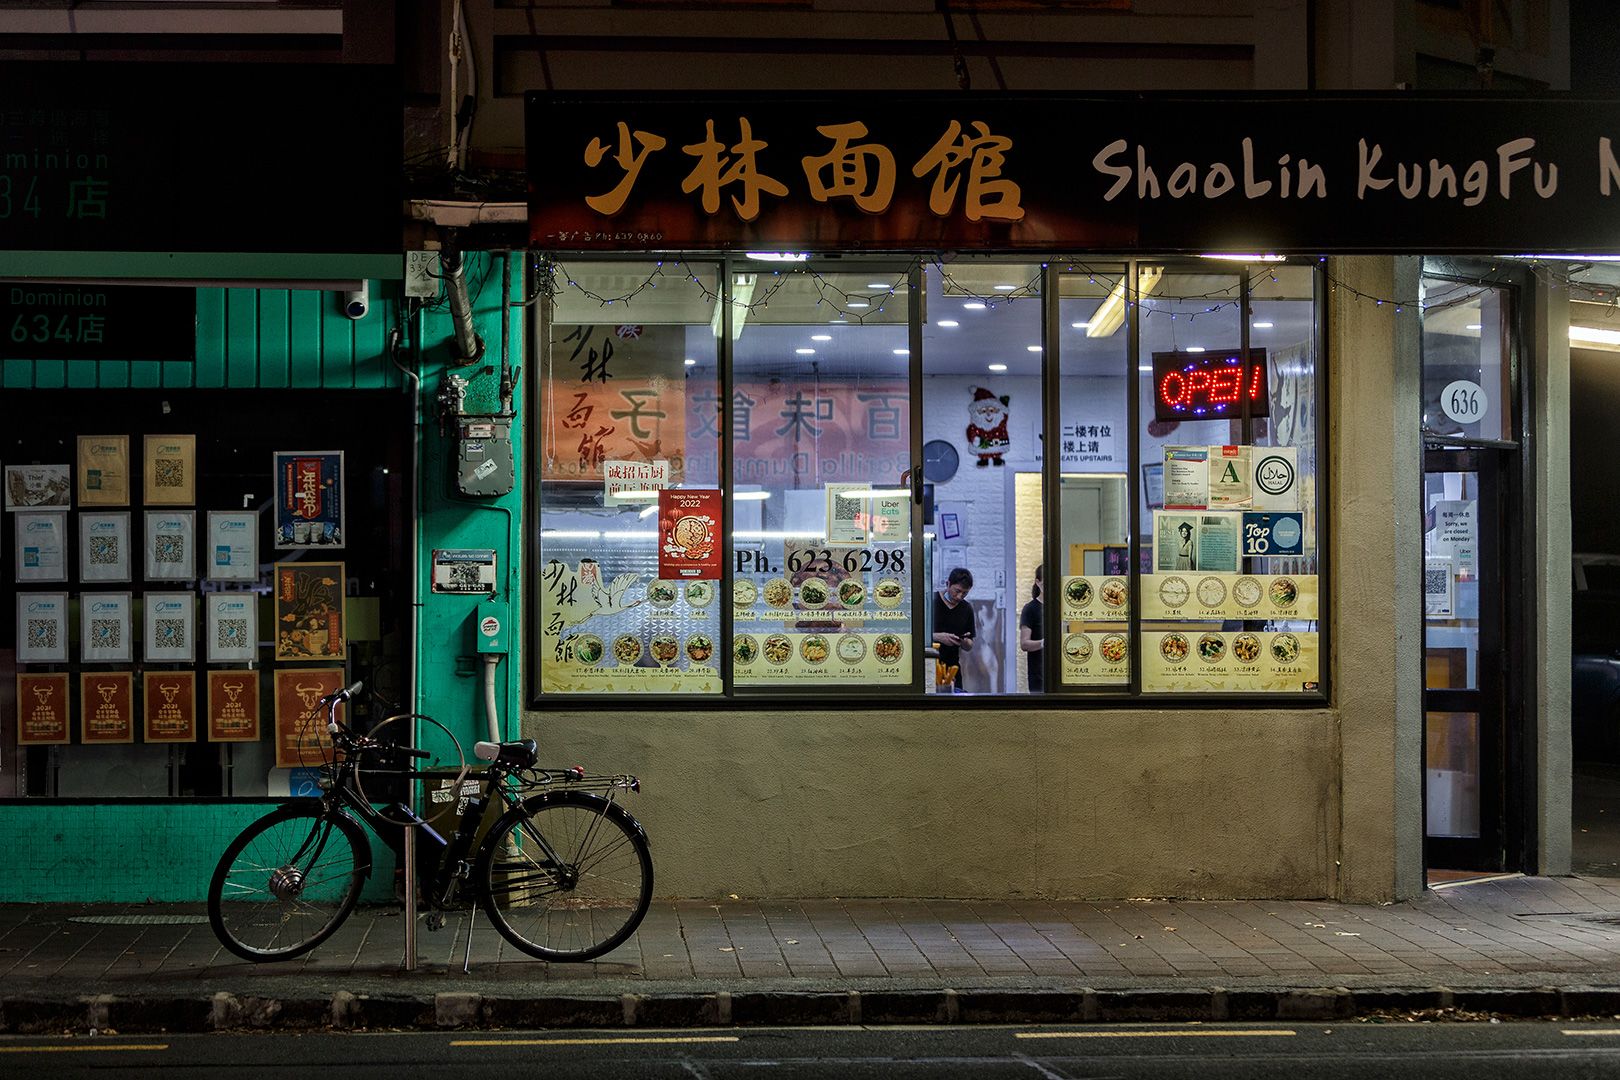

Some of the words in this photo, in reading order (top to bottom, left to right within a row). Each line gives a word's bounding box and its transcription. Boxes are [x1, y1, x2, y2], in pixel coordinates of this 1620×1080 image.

[584, 116, 1025, 221] 少林面馆
[1091, 136, 1327, 202] ShaoLin
[10, 286, 107, 307] Dominion
[1451, 389, 1478, 415] 636
[1220, 460, 1241, 483] A
[680, 500, 701, 508] 2022
[1245, 523, 1270, 538] Top
[1246, 537, 1269, 553] 10
[736, 550, 777, 573] Ph.
[787, 549, 833, 573] 623
[843, 549, 905, 573] 6298
